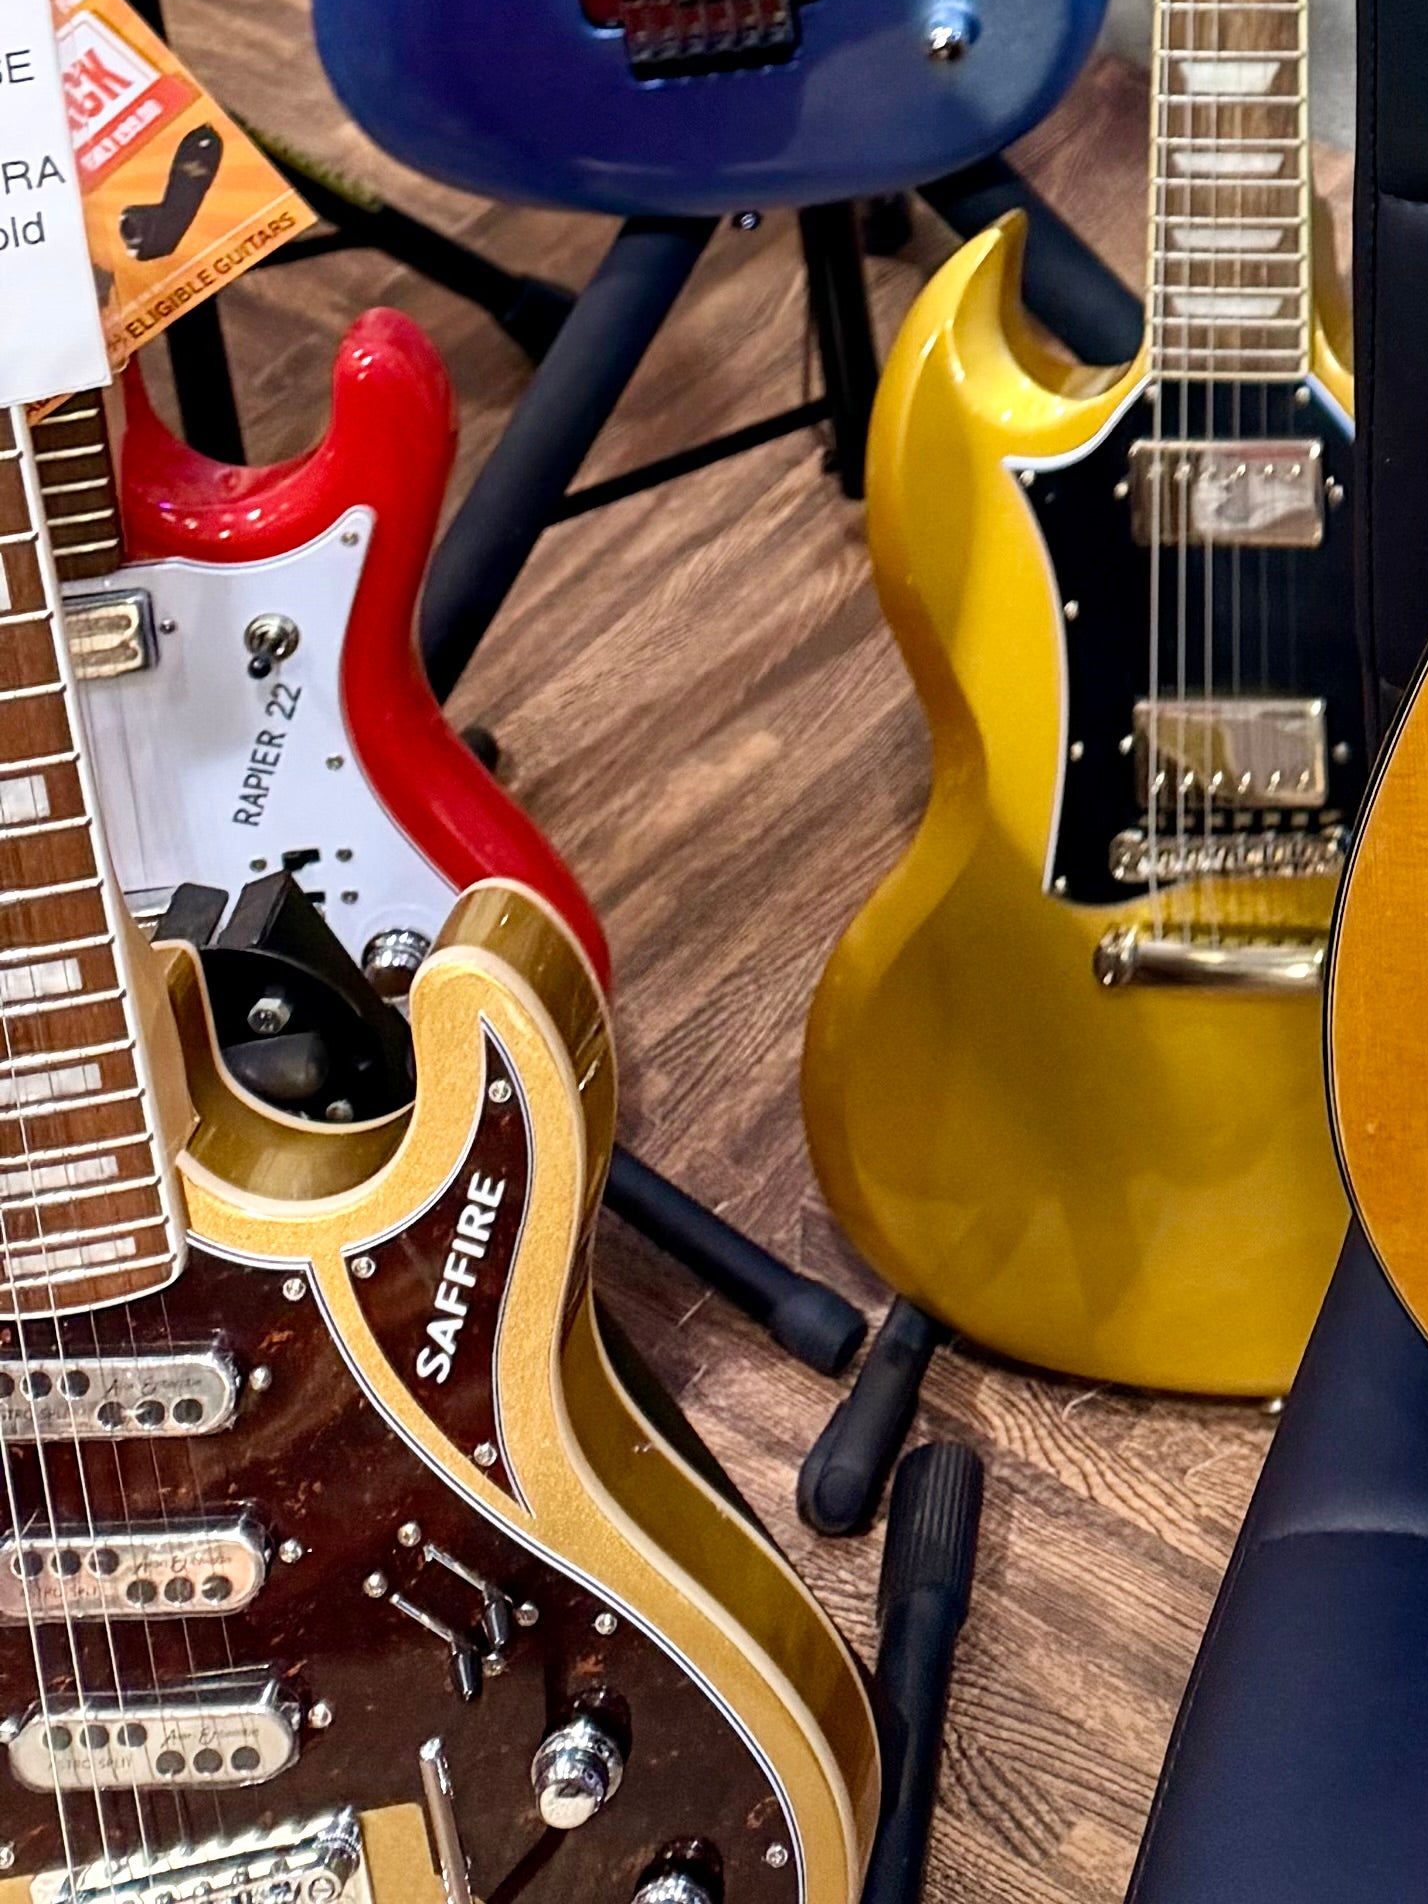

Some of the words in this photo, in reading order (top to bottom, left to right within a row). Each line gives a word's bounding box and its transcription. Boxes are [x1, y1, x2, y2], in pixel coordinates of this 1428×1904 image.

[0, 211, 46, 252] old
[1, 155, 67, 196] RA
[124, 268, 217, 340] ELIGIBLE
[212, 210, 297, 276] GUITARS
[231, 729, 288, 828] RAPIER
[264, 682, 302, 721] 22
[416, 1169, 508, 1386] SAFFIRE
